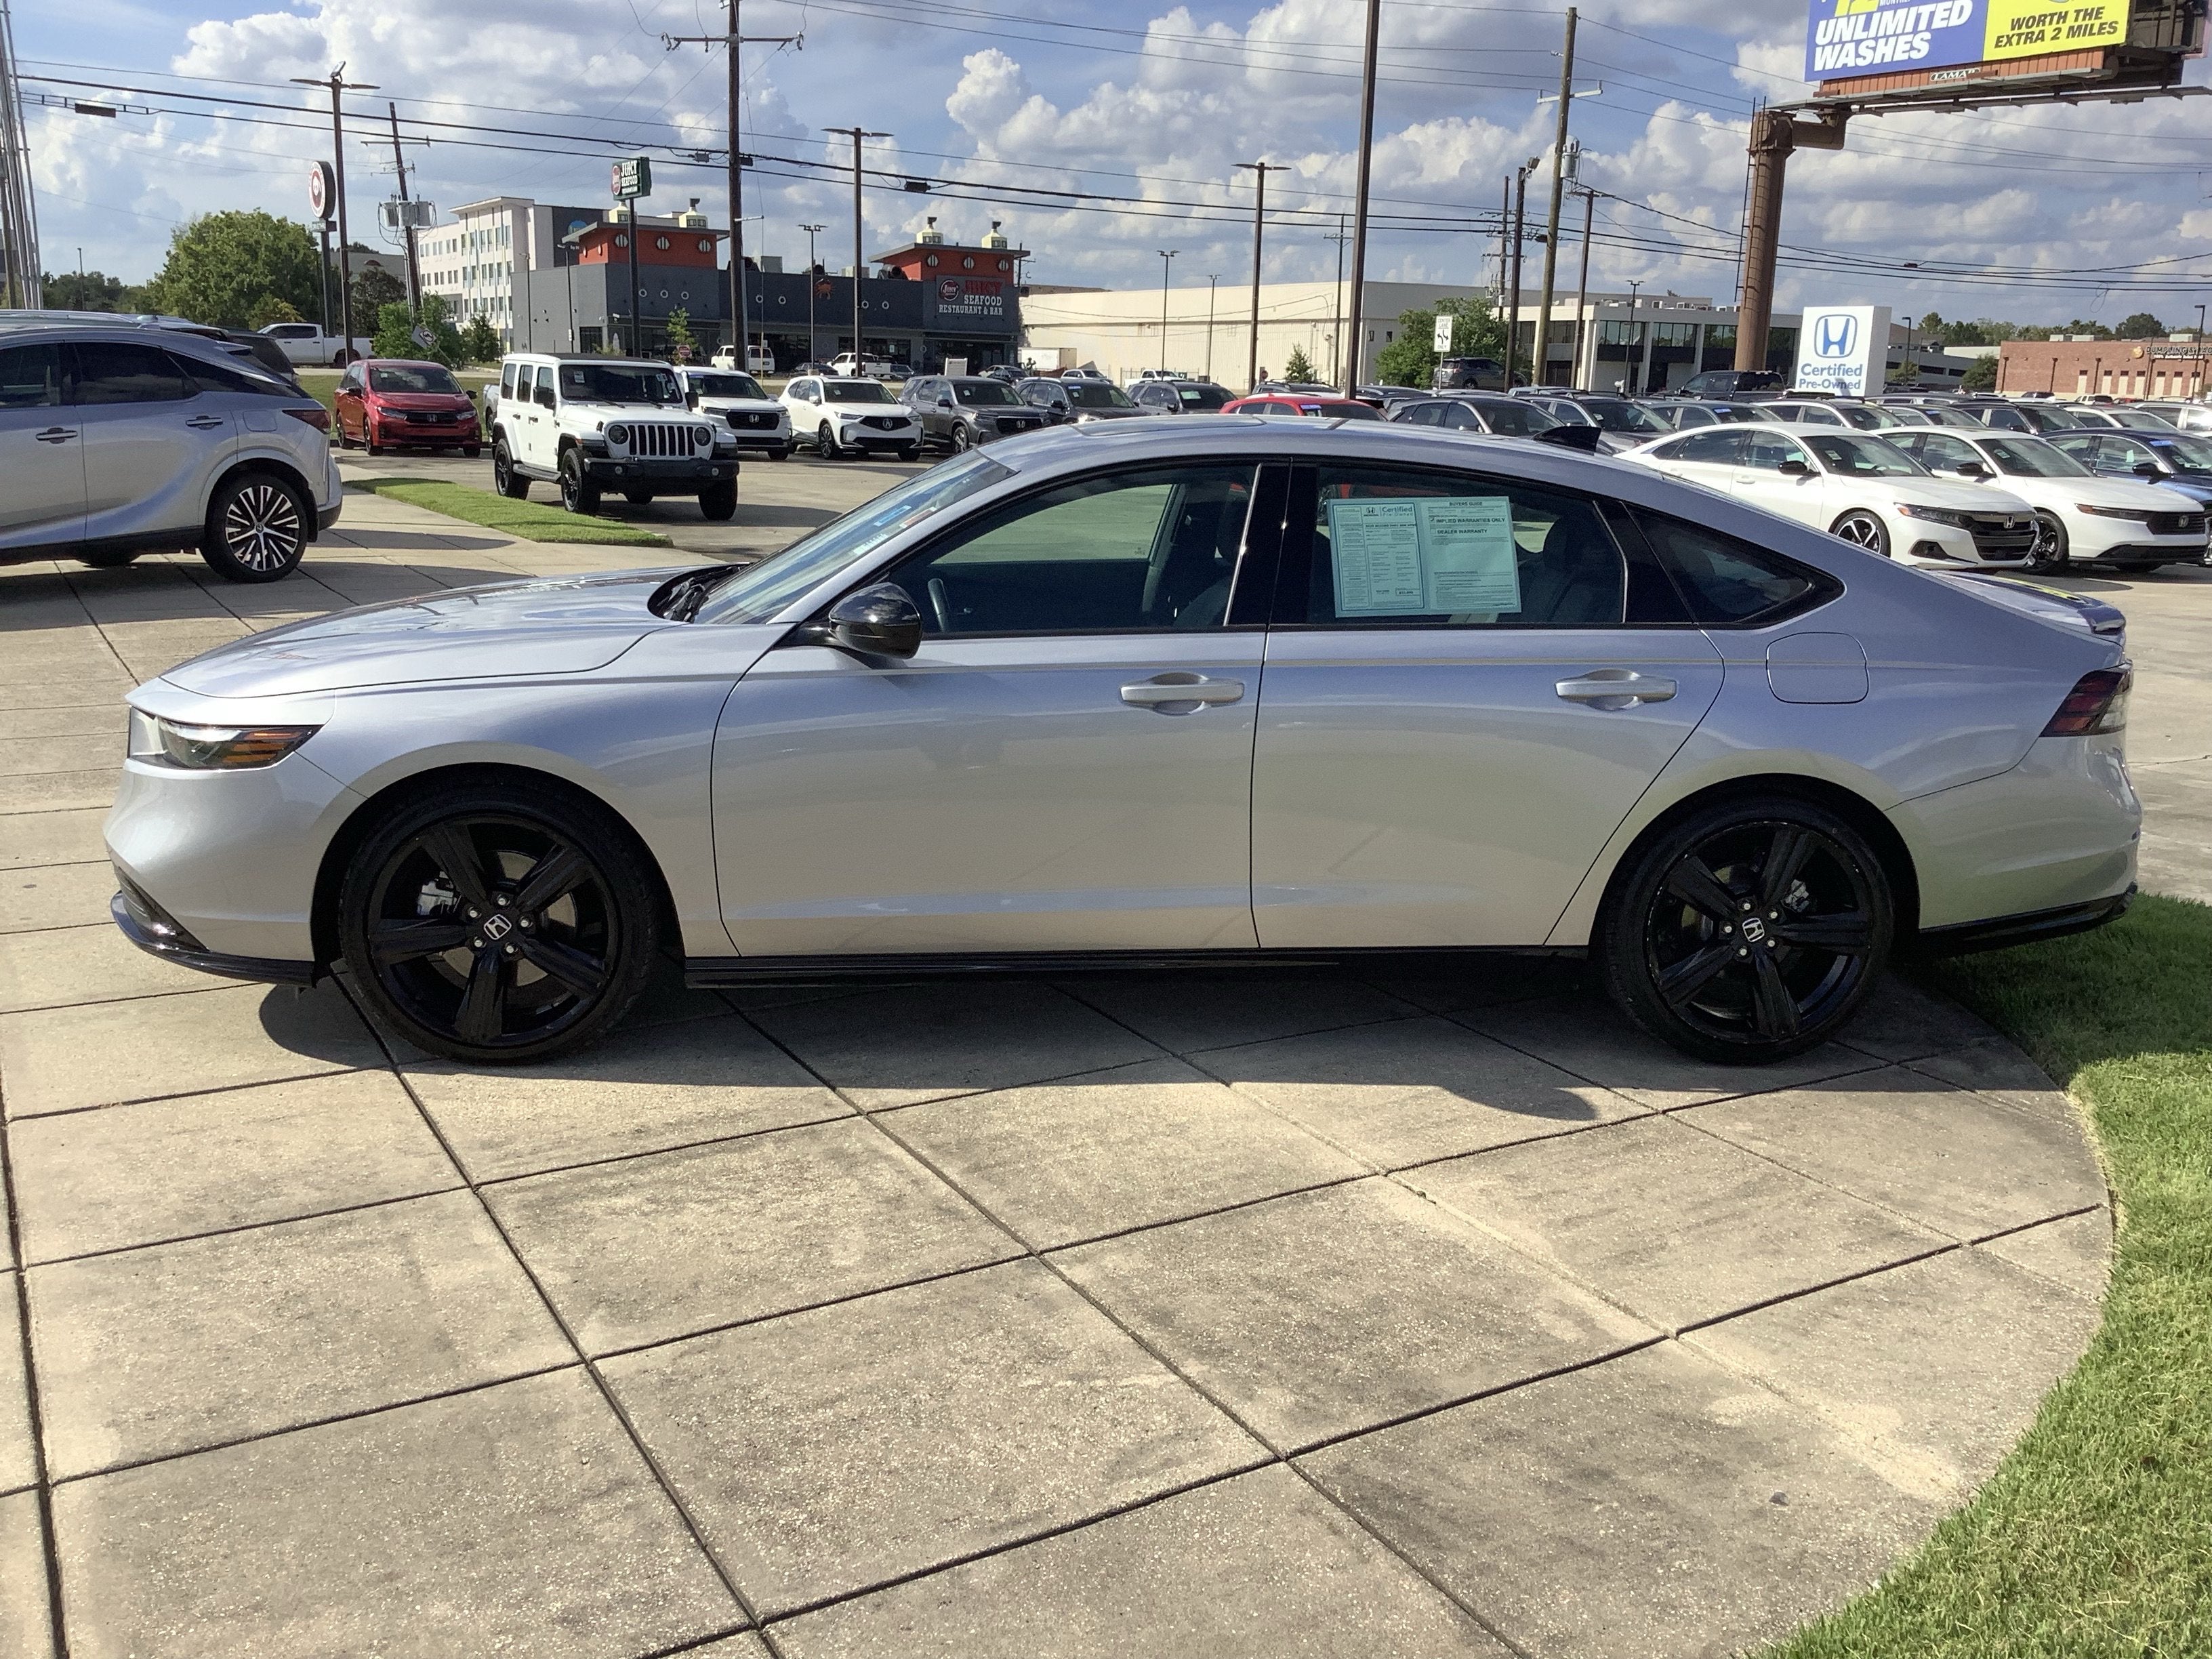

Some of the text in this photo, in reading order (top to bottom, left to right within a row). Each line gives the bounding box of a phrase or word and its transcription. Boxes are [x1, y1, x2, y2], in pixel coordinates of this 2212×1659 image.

[1815, 0, 1973, 45] UNLIMITED
[2010, 6, 2105, 31] WORTH THE
[1994, 20, 2119, 49] EXTRA 2 MILES
[1814, 32, 1931, 71] WASHES
[621, 160, 637, 176] JUICY
[962, 280, 1004, 295] JUICY
[964, 295, 1002, 306] SEAFOOD
[939, 304, 981, 314] RESTAURANT
[990, 307, 1002, 315] BAR
[1801, 363, 1863, 376] Certified
[1799, 378, 1861, 389] Pre-Owned
